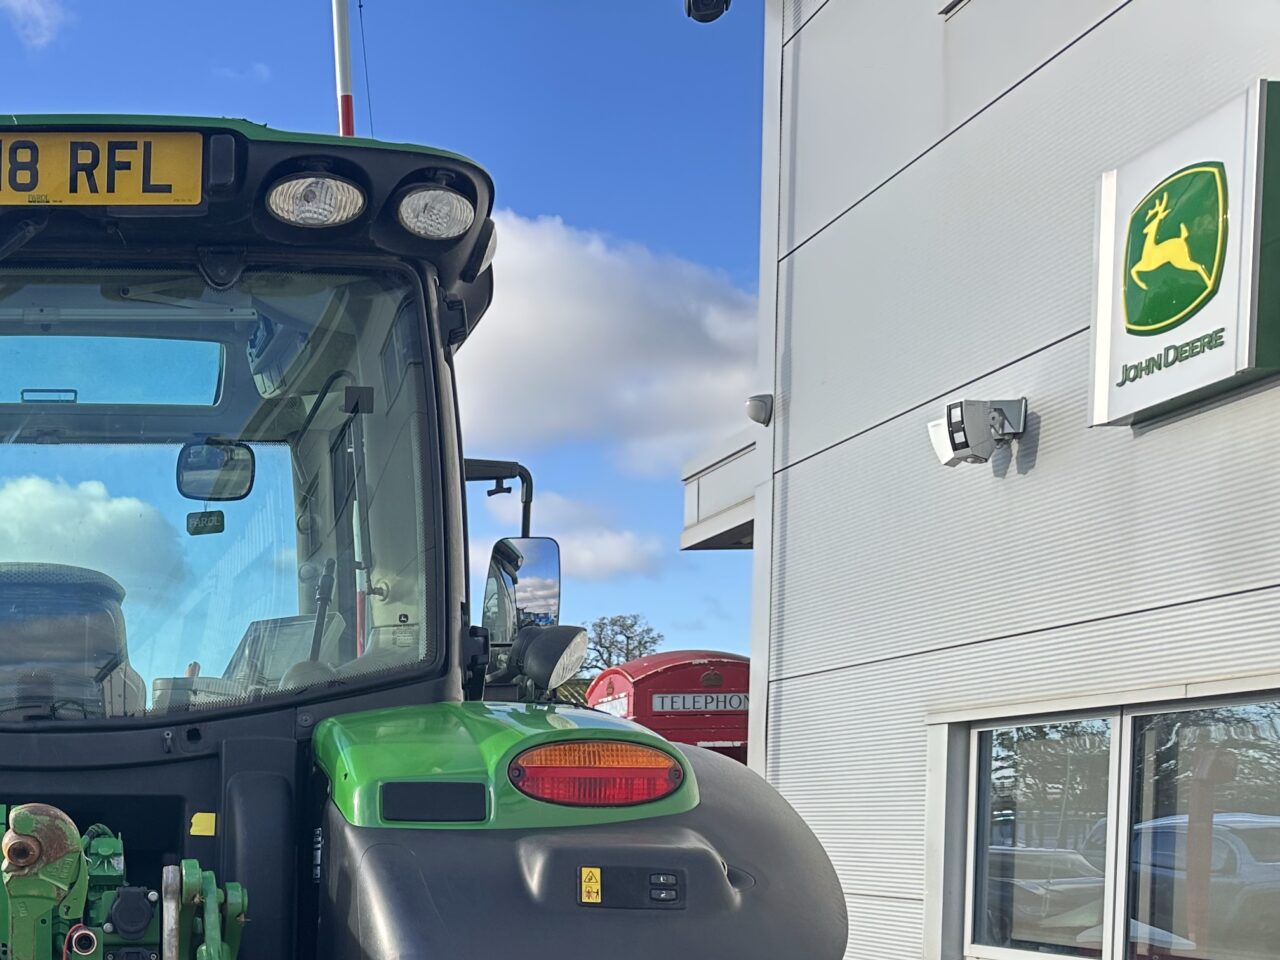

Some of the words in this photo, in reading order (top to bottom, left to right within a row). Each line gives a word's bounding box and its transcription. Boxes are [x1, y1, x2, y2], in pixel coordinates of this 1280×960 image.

[69, 141, 173, 194] RFL
[1116, 352, 1162, 387] JOHN
[1163, 327, 1225, 368] DEERE
